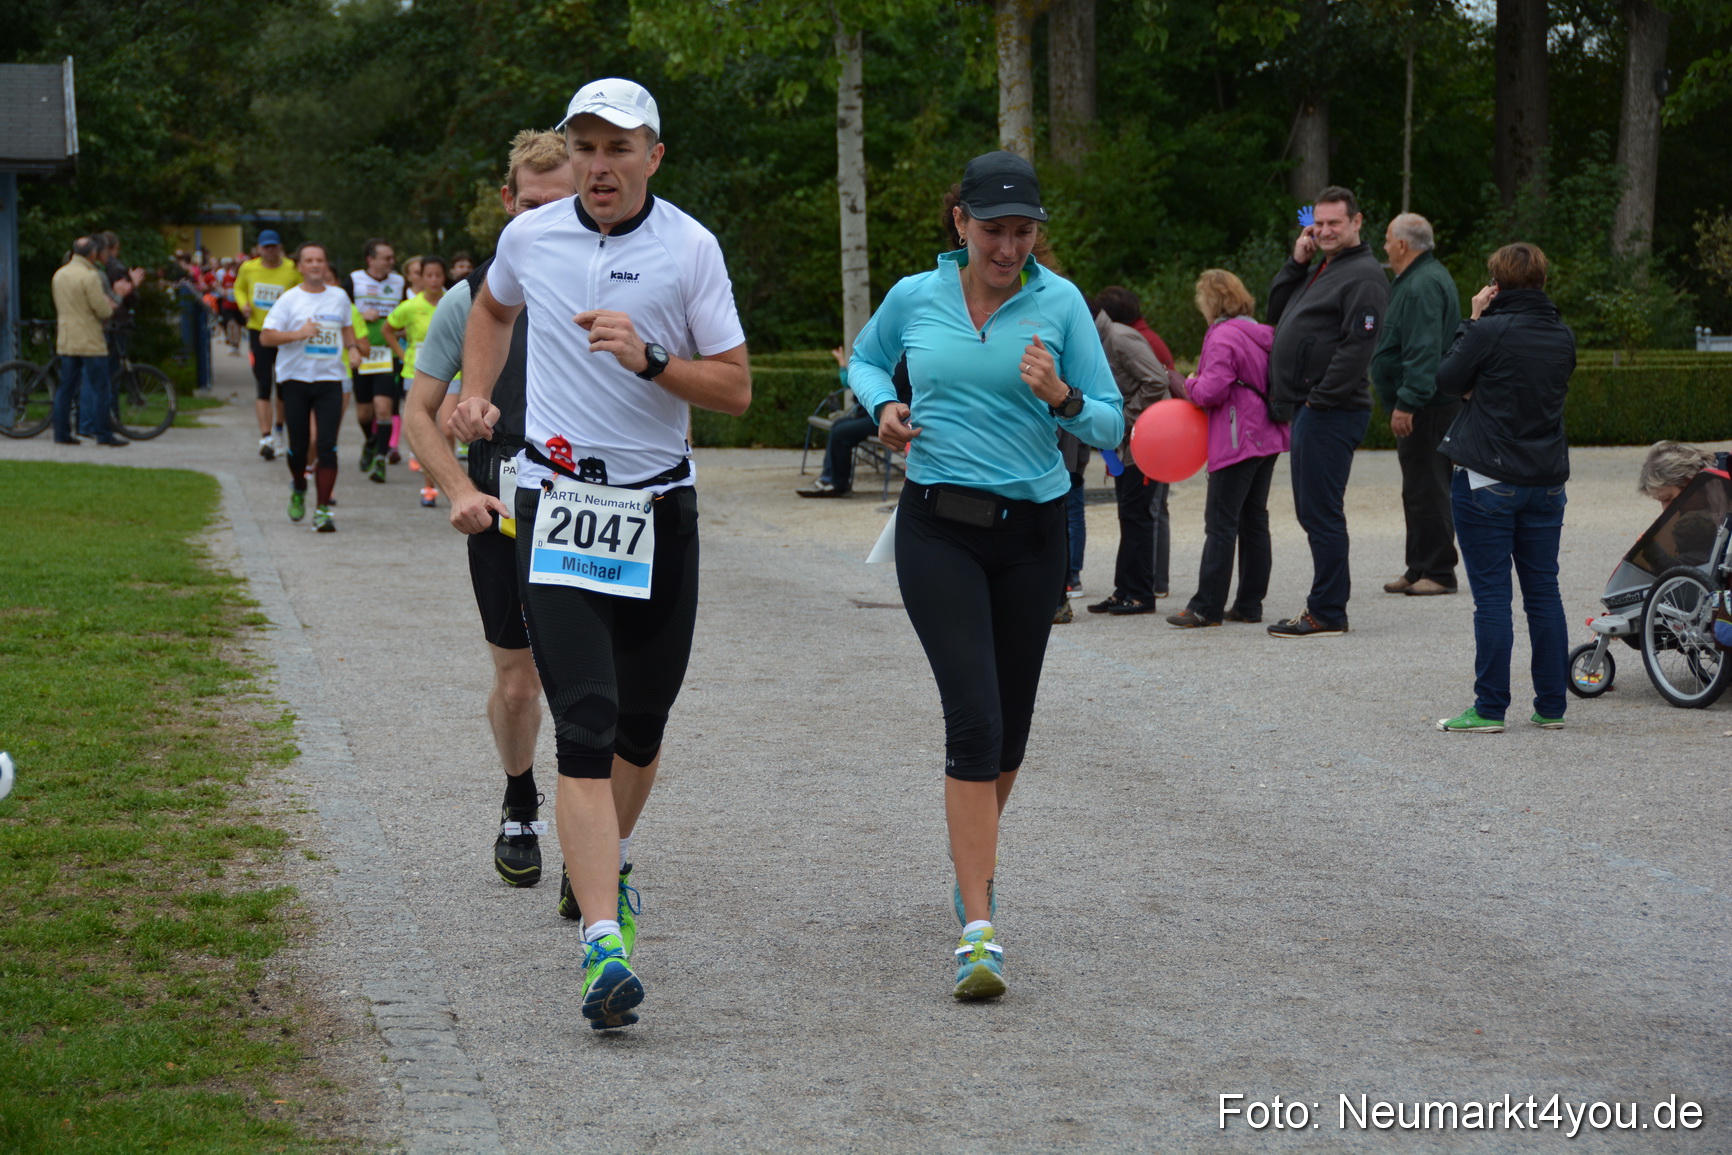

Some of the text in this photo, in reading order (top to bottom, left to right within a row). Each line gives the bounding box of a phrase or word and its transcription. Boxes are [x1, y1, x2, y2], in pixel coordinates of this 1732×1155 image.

[610, 270, 641, 281] kalas
[543, 490, 641, 511] PARTL Neumarkt
[546, 506, 647, 555] 2047
[562, 556, 622, 581] Michael
